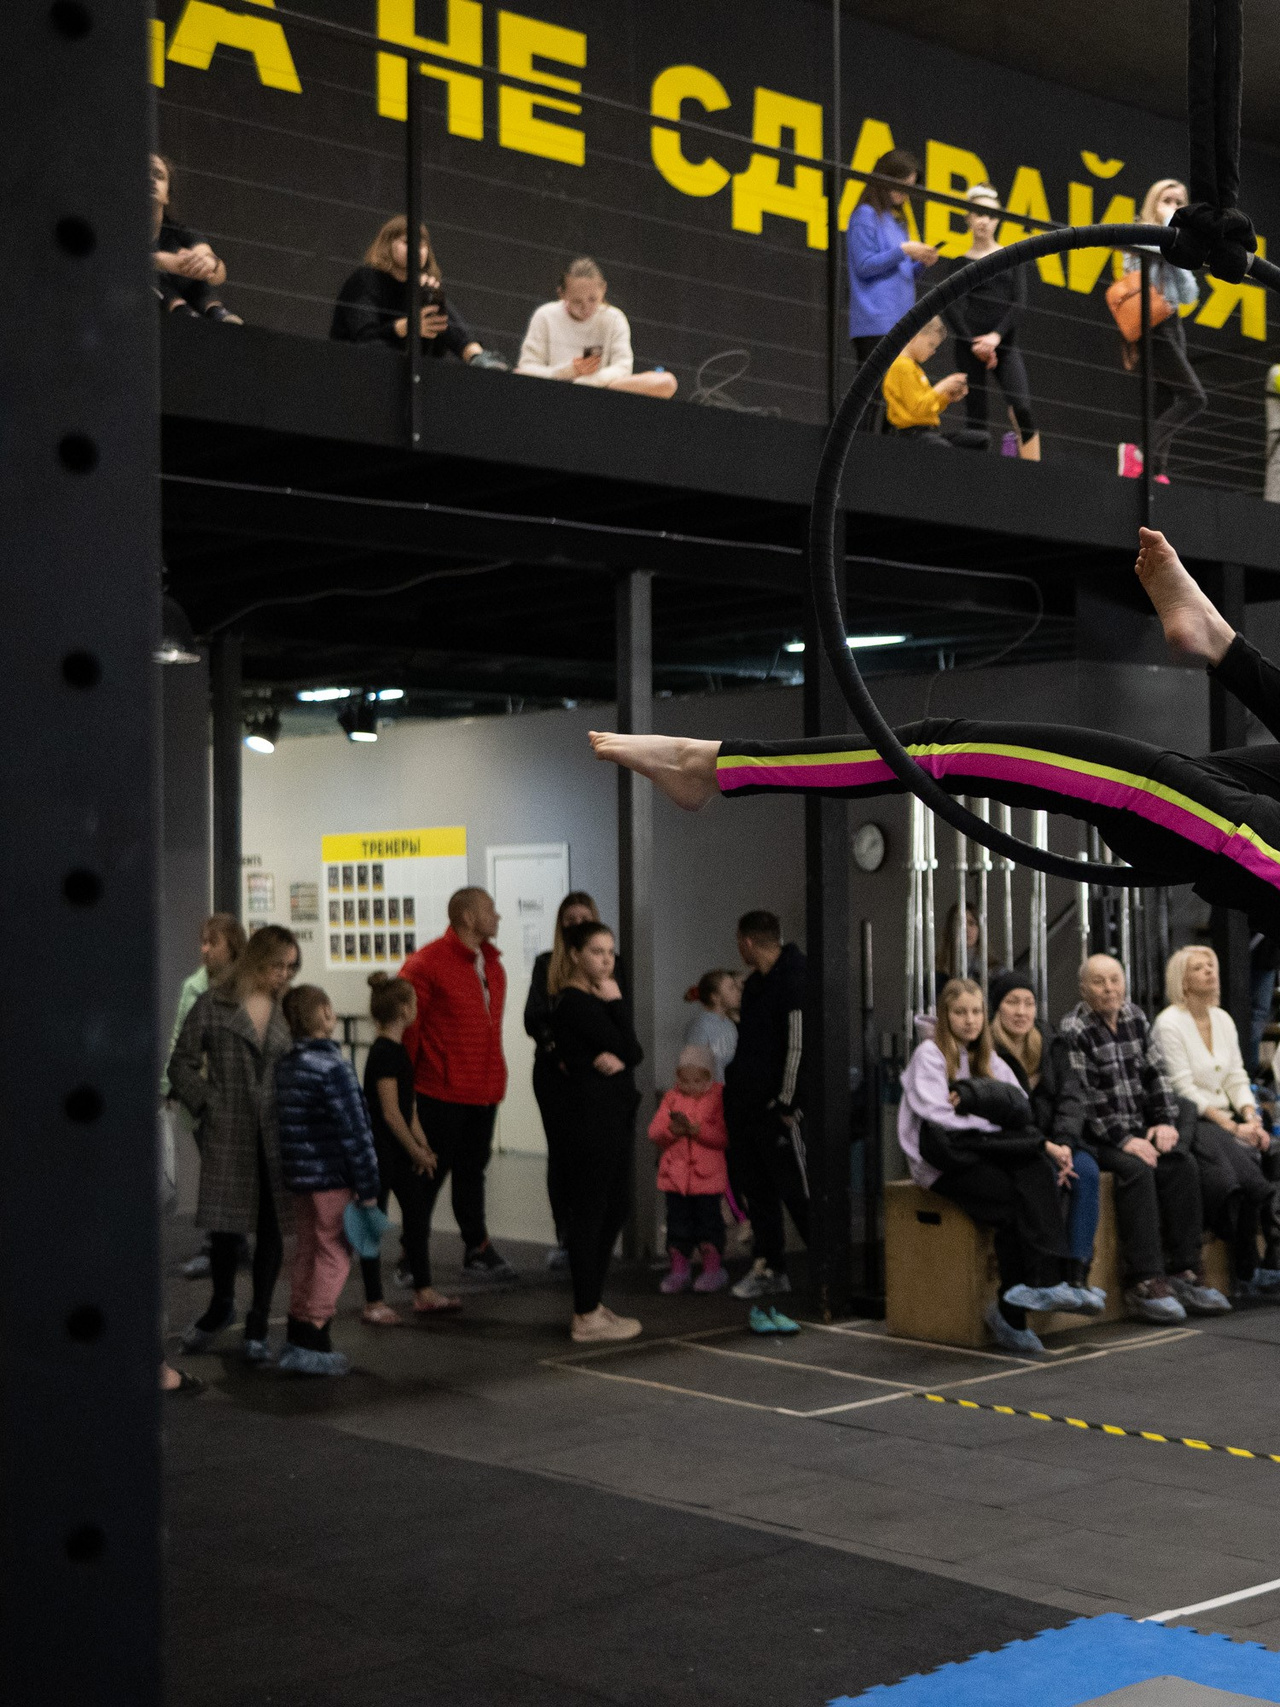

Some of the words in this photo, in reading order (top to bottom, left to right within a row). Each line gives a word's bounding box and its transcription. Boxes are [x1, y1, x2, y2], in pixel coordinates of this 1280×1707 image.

[147, 0, 302, 94] А
[377, 0, 587, 167] НЕ
[650, 64, 1267, 342] СДАВАЙЯ
[362, 838, 420, 857] ТРЕНЕРЫ
